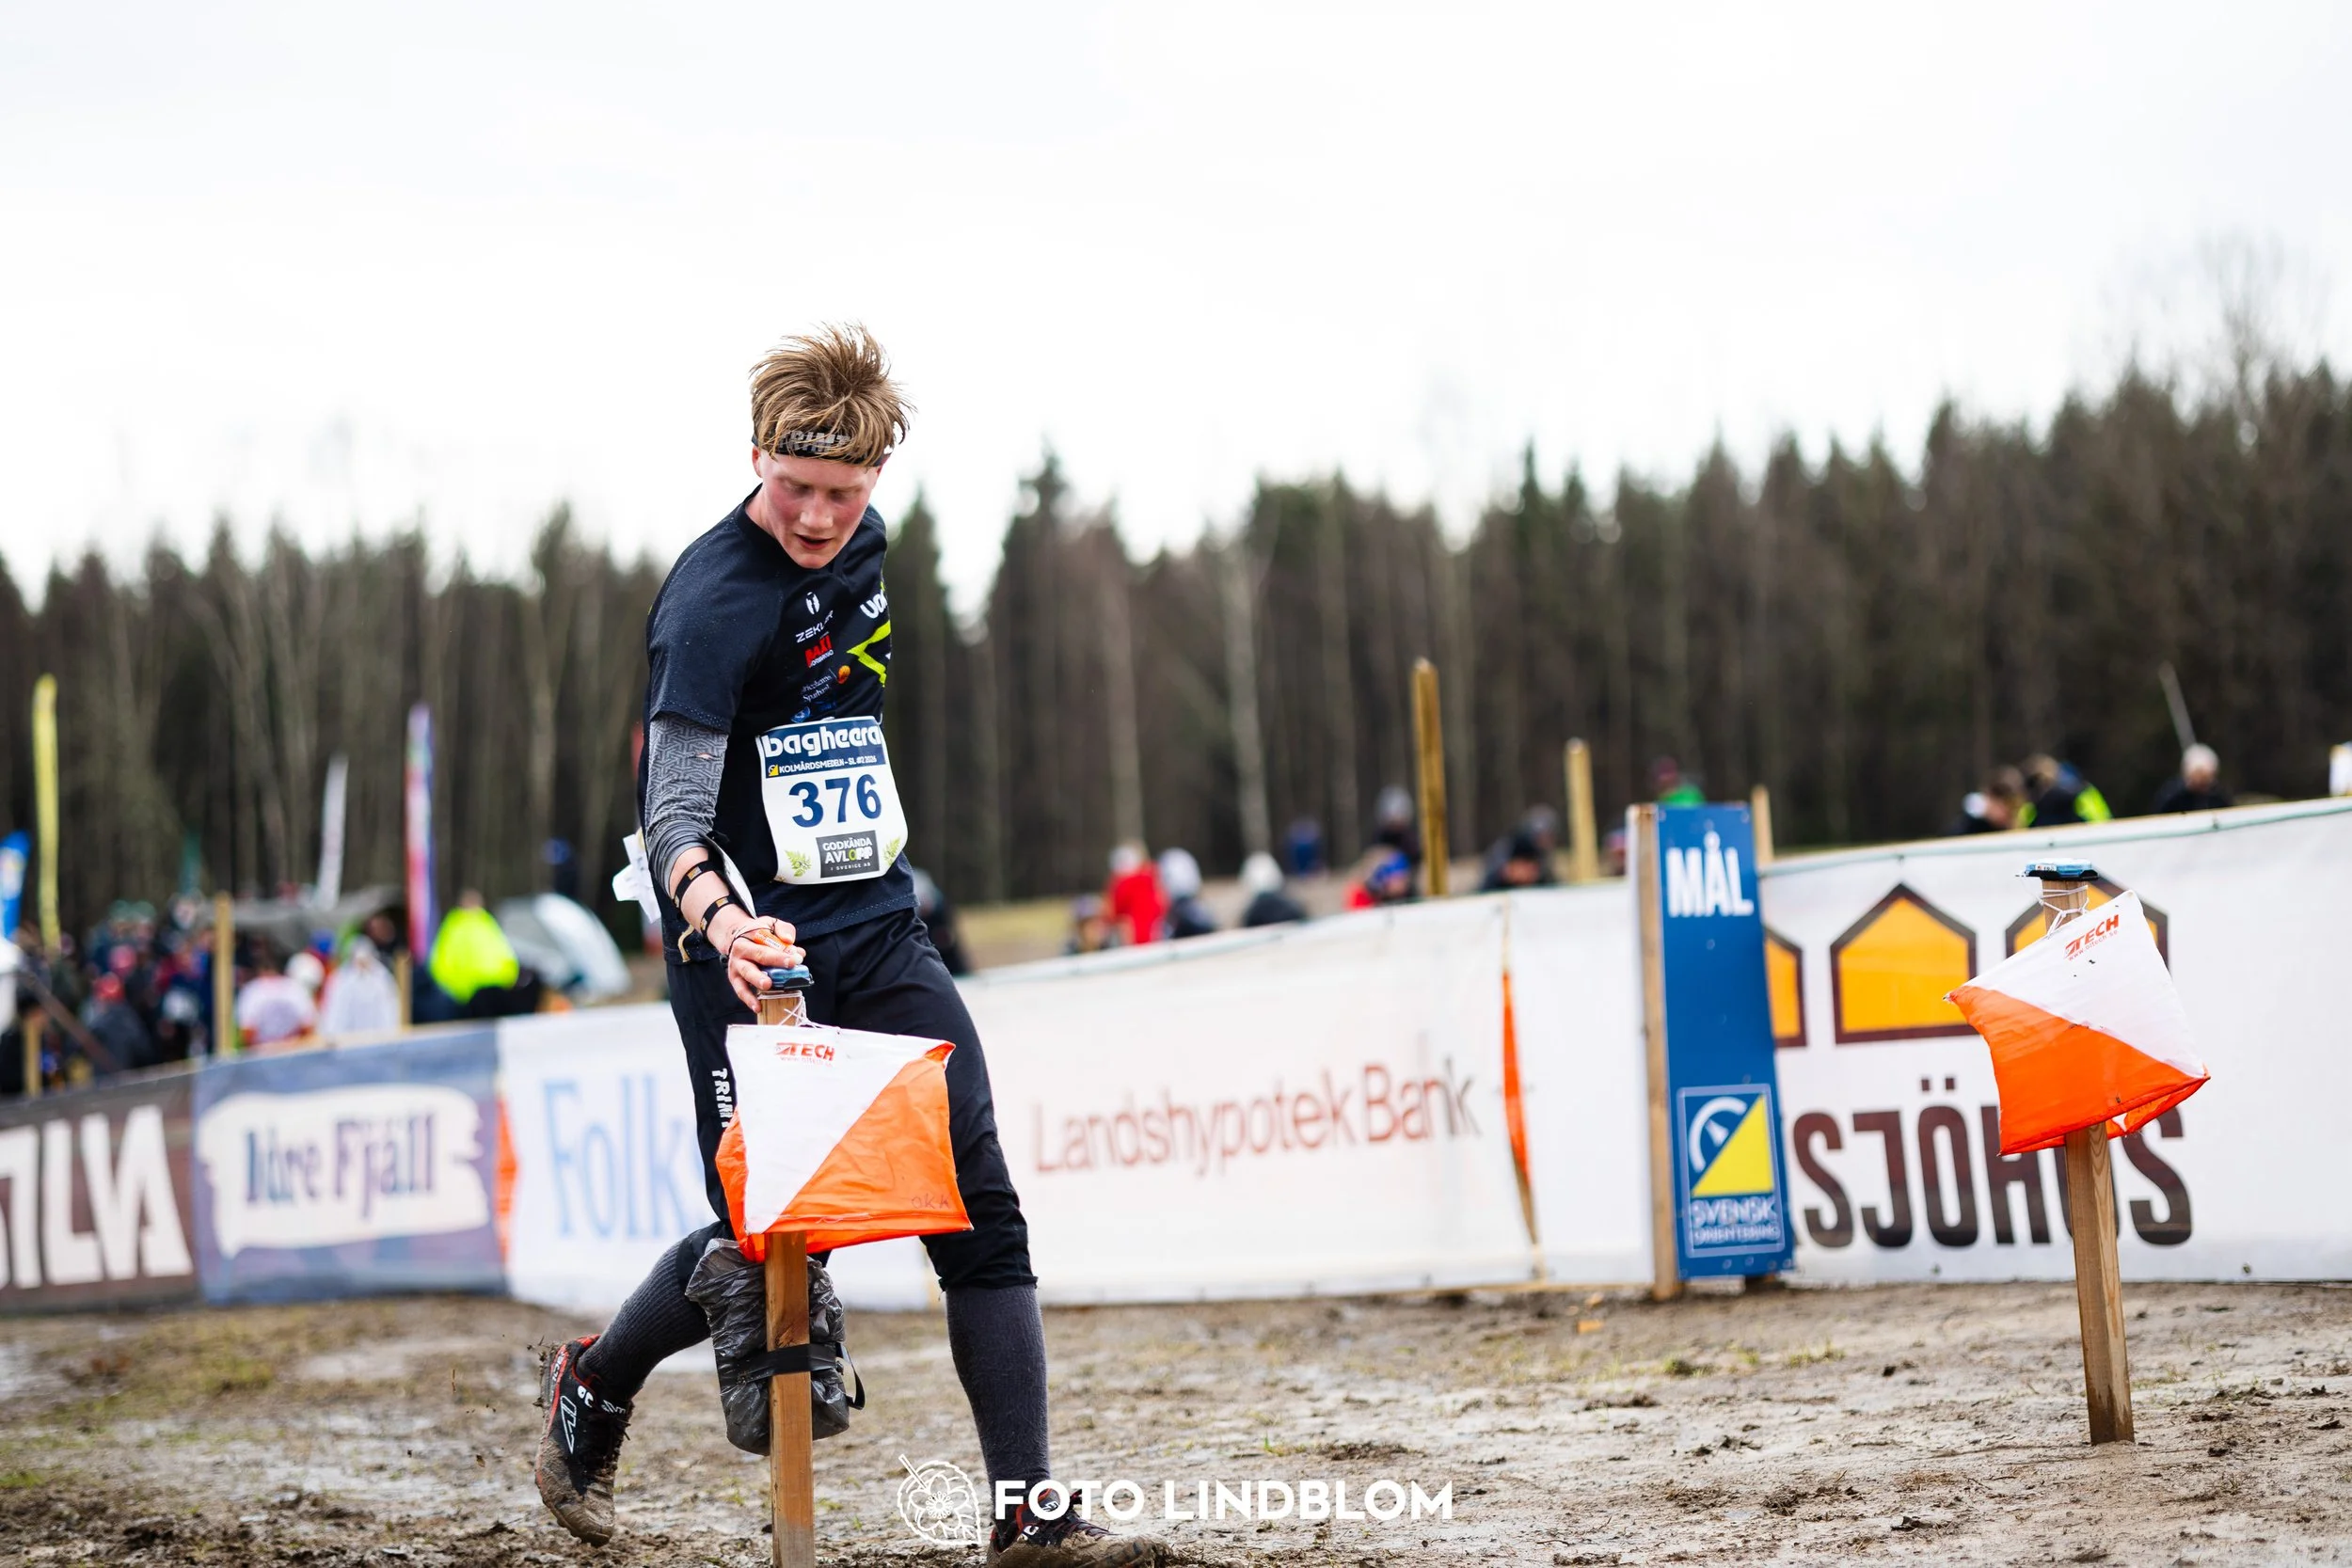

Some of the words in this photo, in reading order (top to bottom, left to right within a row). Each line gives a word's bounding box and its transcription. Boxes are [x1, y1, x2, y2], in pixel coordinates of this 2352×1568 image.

[761, 725, 882, 758] bagheera
[789, 774, 882, 828] 376
[822, 836, 873, 851] GODKÄNDA
[1666, 831, 1754, 917] MÅL
[1032, 1067, 1356, 1177] Landshypotek
[1363, 1055, 1482, 1145] Bank
[542, 1072, 705, 1240] Folk
[0, 1104, 194, 1290] ILVA
[1691, 1196, 1778, 1227] SVENSK
